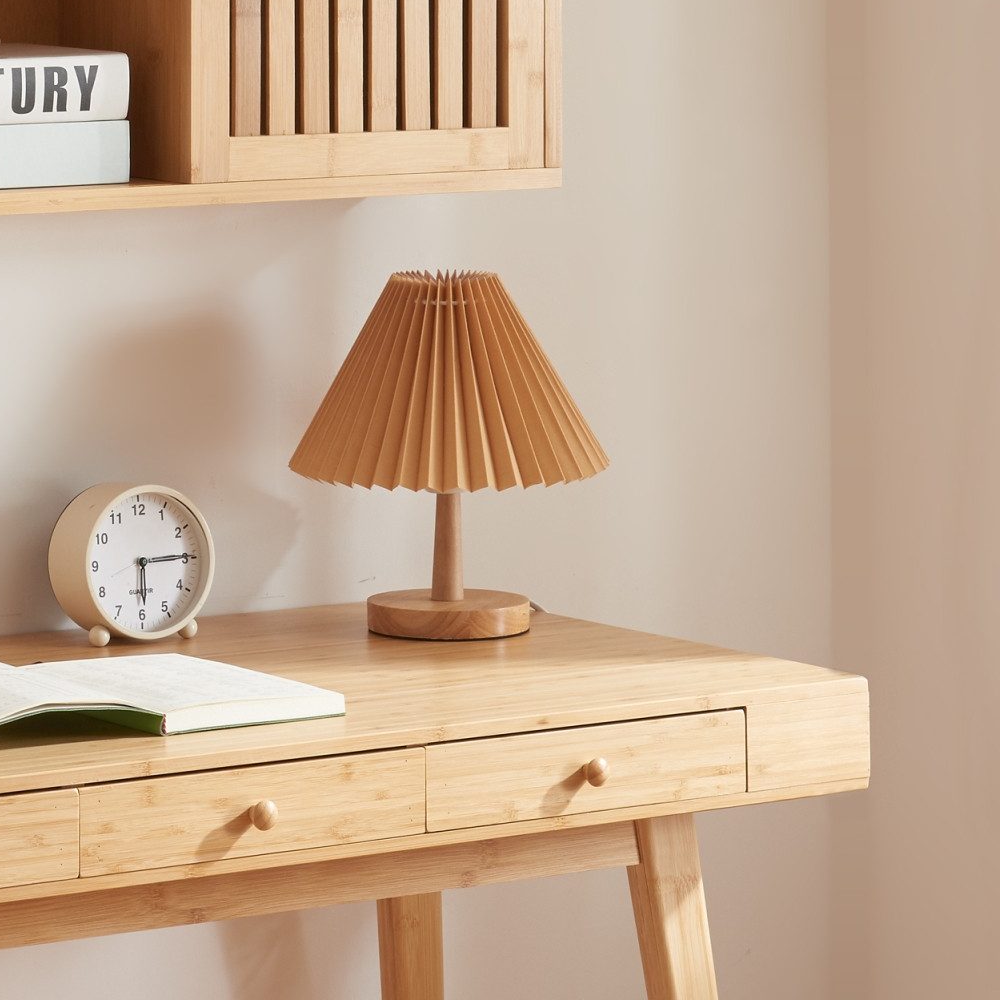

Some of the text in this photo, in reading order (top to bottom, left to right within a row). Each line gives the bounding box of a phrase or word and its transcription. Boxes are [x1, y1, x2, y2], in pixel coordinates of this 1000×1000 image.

[131, 504, 146, 516] 12
[158, 509, 164, 521] 1
[109, 512, 122, 525] 11
[174, 526, 182, 538] 2
[96, 533, 108, 545] 10
[91, 561, 99, 572] 9
[176, 579, 183, 591] 4
[98, 586, 106, 598] 8
[115, 605, 123, 617] 7
[161, 601, 169, 613] 5
[138, 609, 146, 621] 6
